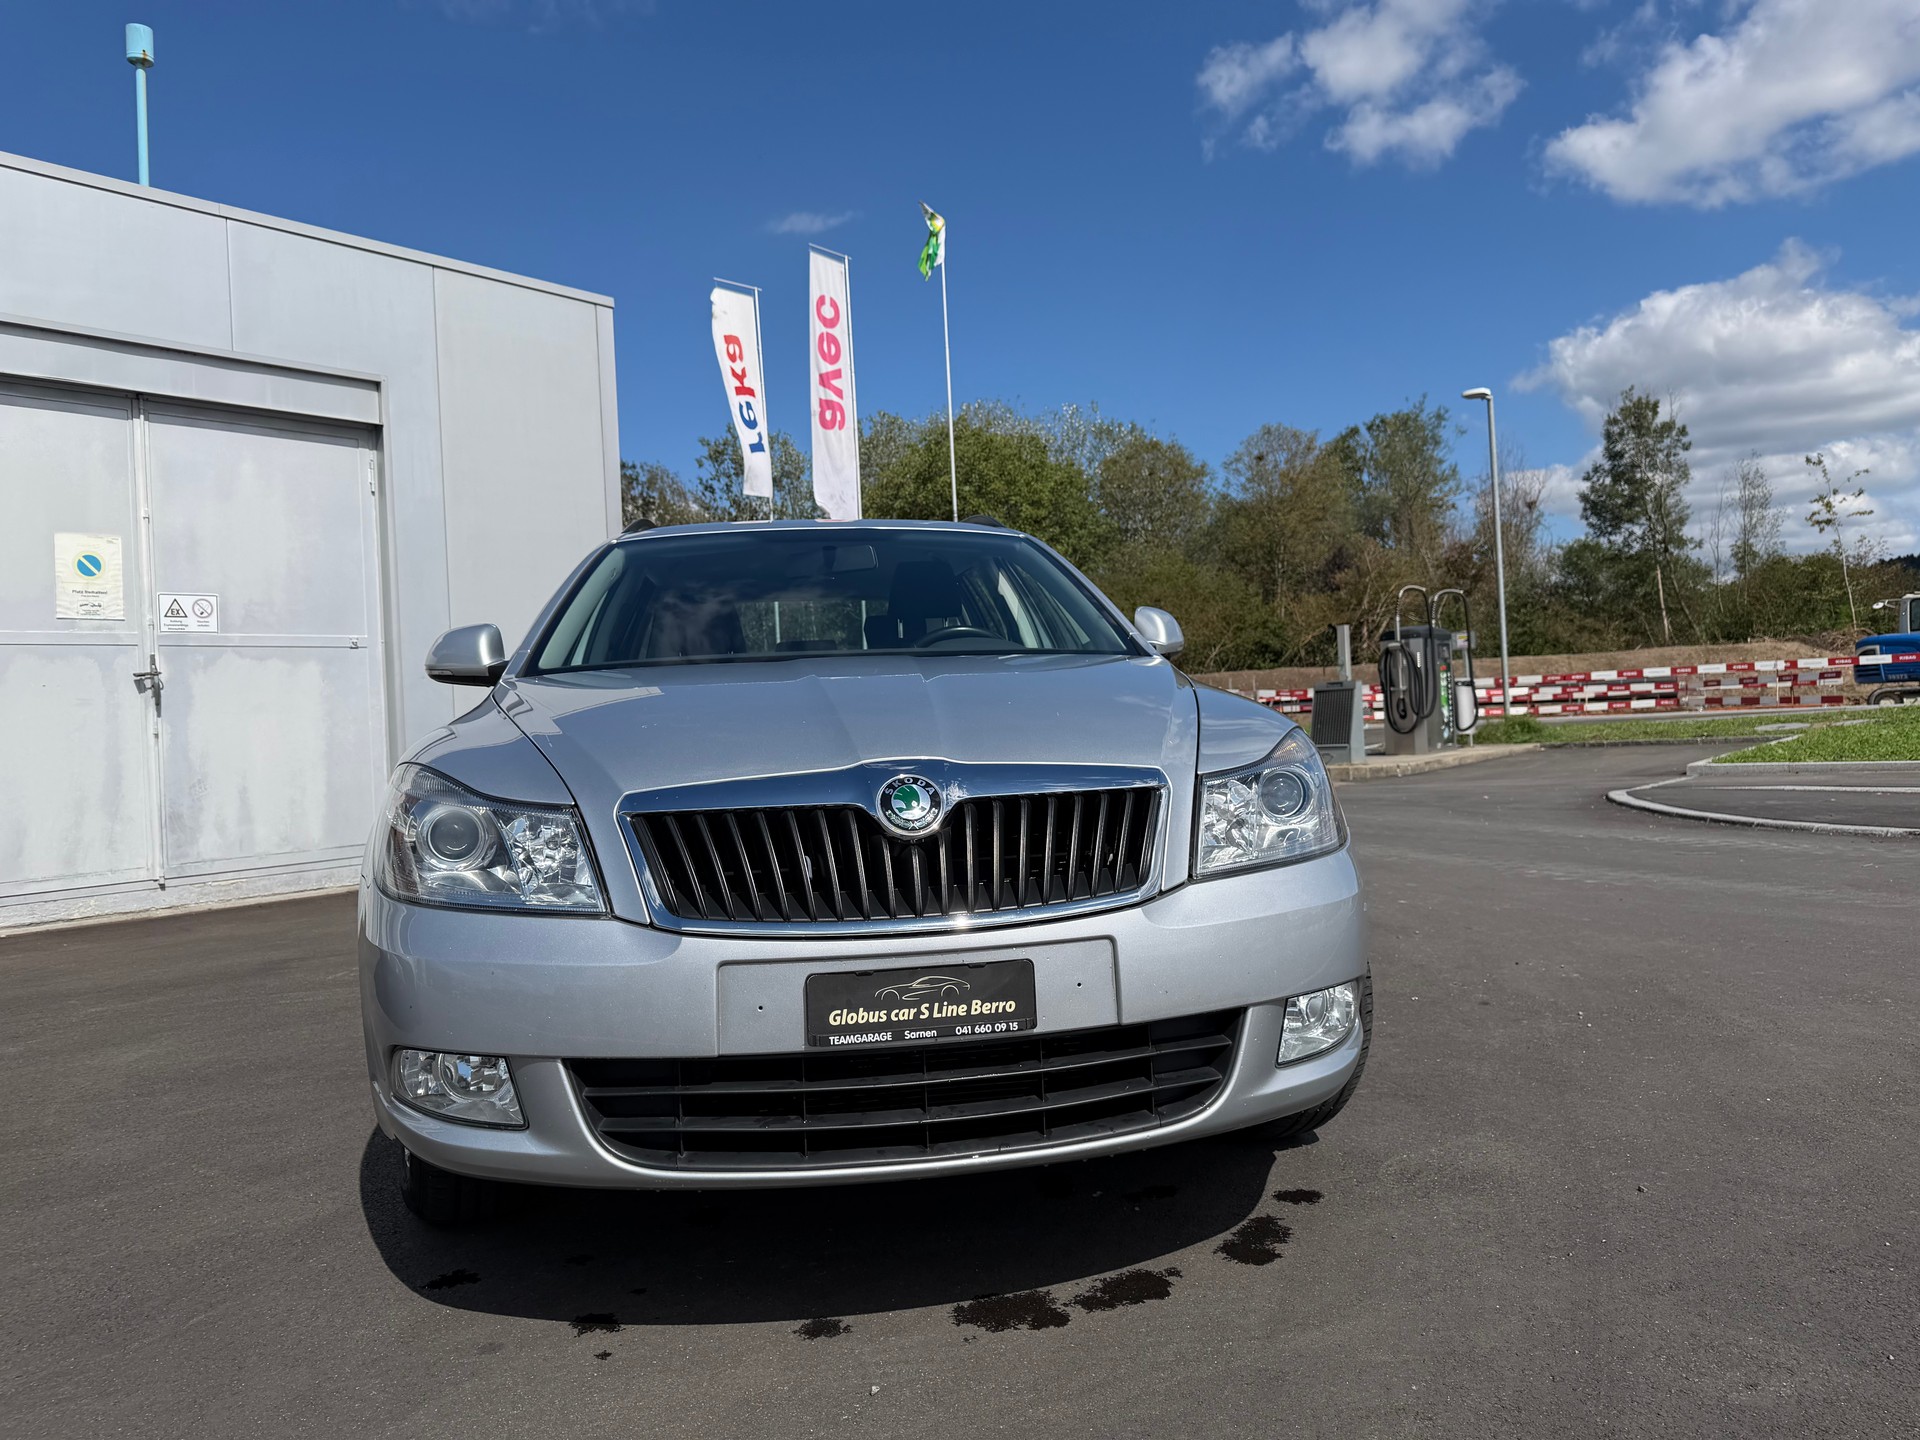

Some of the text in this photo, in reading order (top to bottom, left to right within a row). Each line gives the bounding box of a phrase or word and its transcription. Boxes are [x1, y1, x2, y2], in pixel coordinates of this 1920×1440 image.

[170, 608, 181, 616] EX
[828, 999, 1016, 1026] Globus car S Line Berro
[828, 1021, 1018, 1046] TEAMGARAGE Sarnen 041 660 09 15
